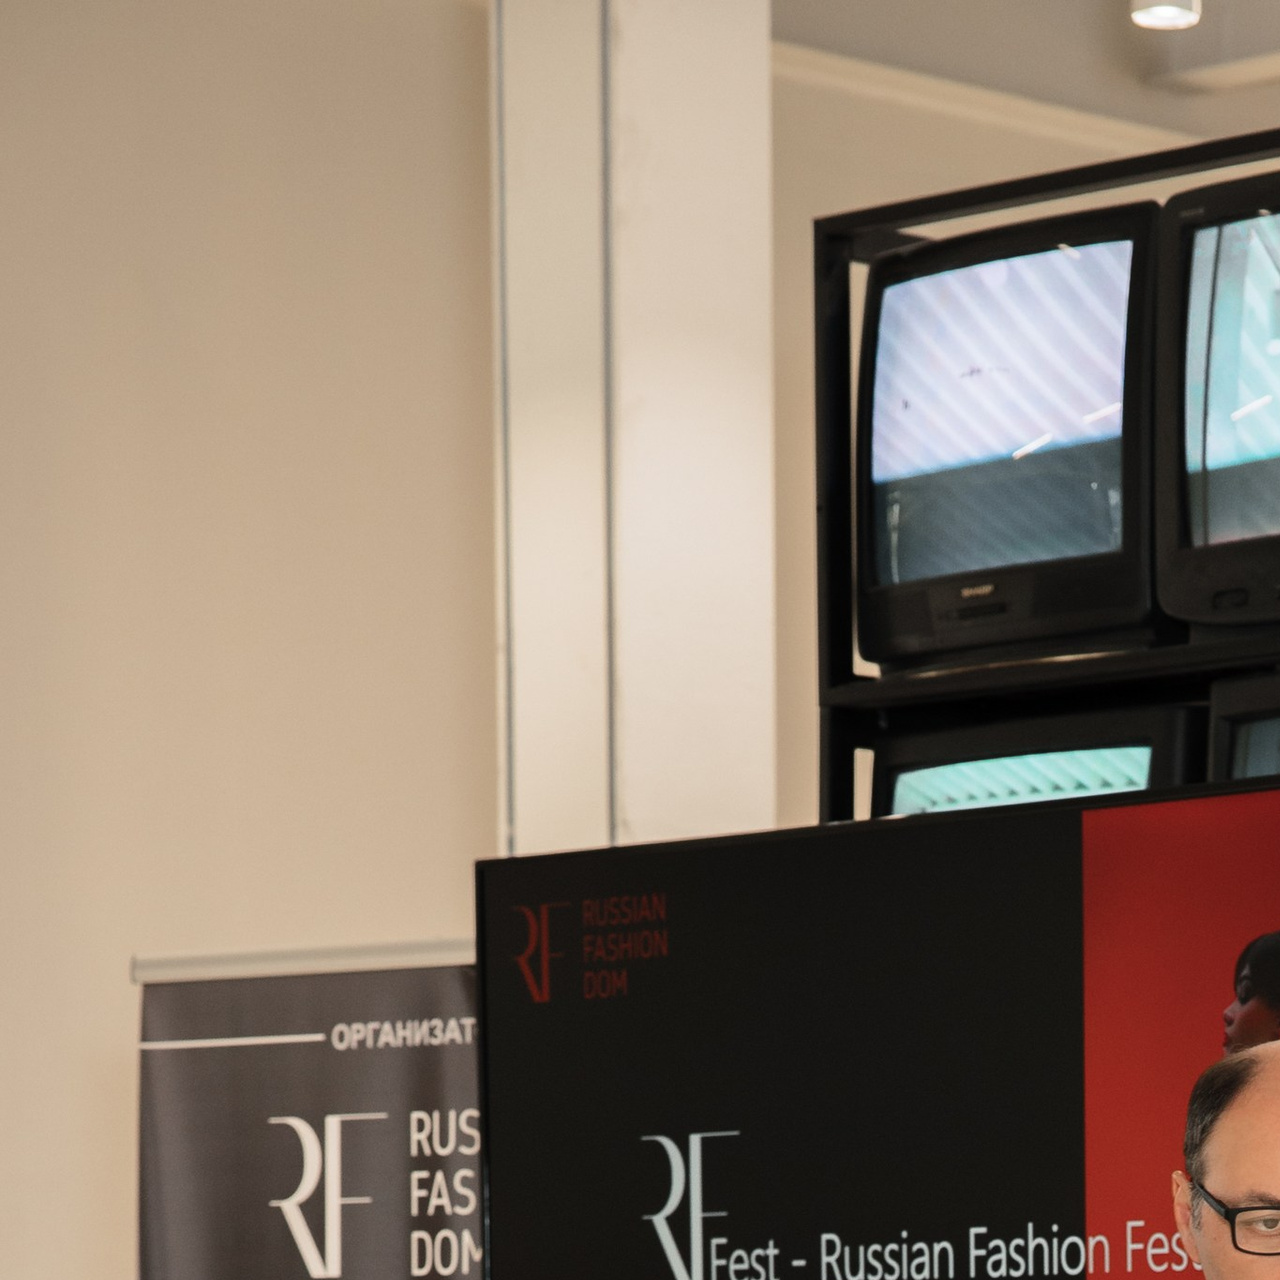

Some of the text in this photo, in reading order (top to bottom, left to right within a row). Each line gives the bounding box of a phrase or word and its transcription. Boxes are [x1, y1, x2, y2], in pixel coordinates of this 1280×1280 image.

[582, 893, 667, 927] RUSSIAN
[583, 929, 669, 963] FASHION
[583, 969, 628, 999] DOM
[331, 1017, 477, 1051] ОРГАНИЗАТ
[410, 1107, 481, 1157] RUS
[410, 1168, 478, 1217] FAS
[968, 1222, 1111, 1279] Fashion
